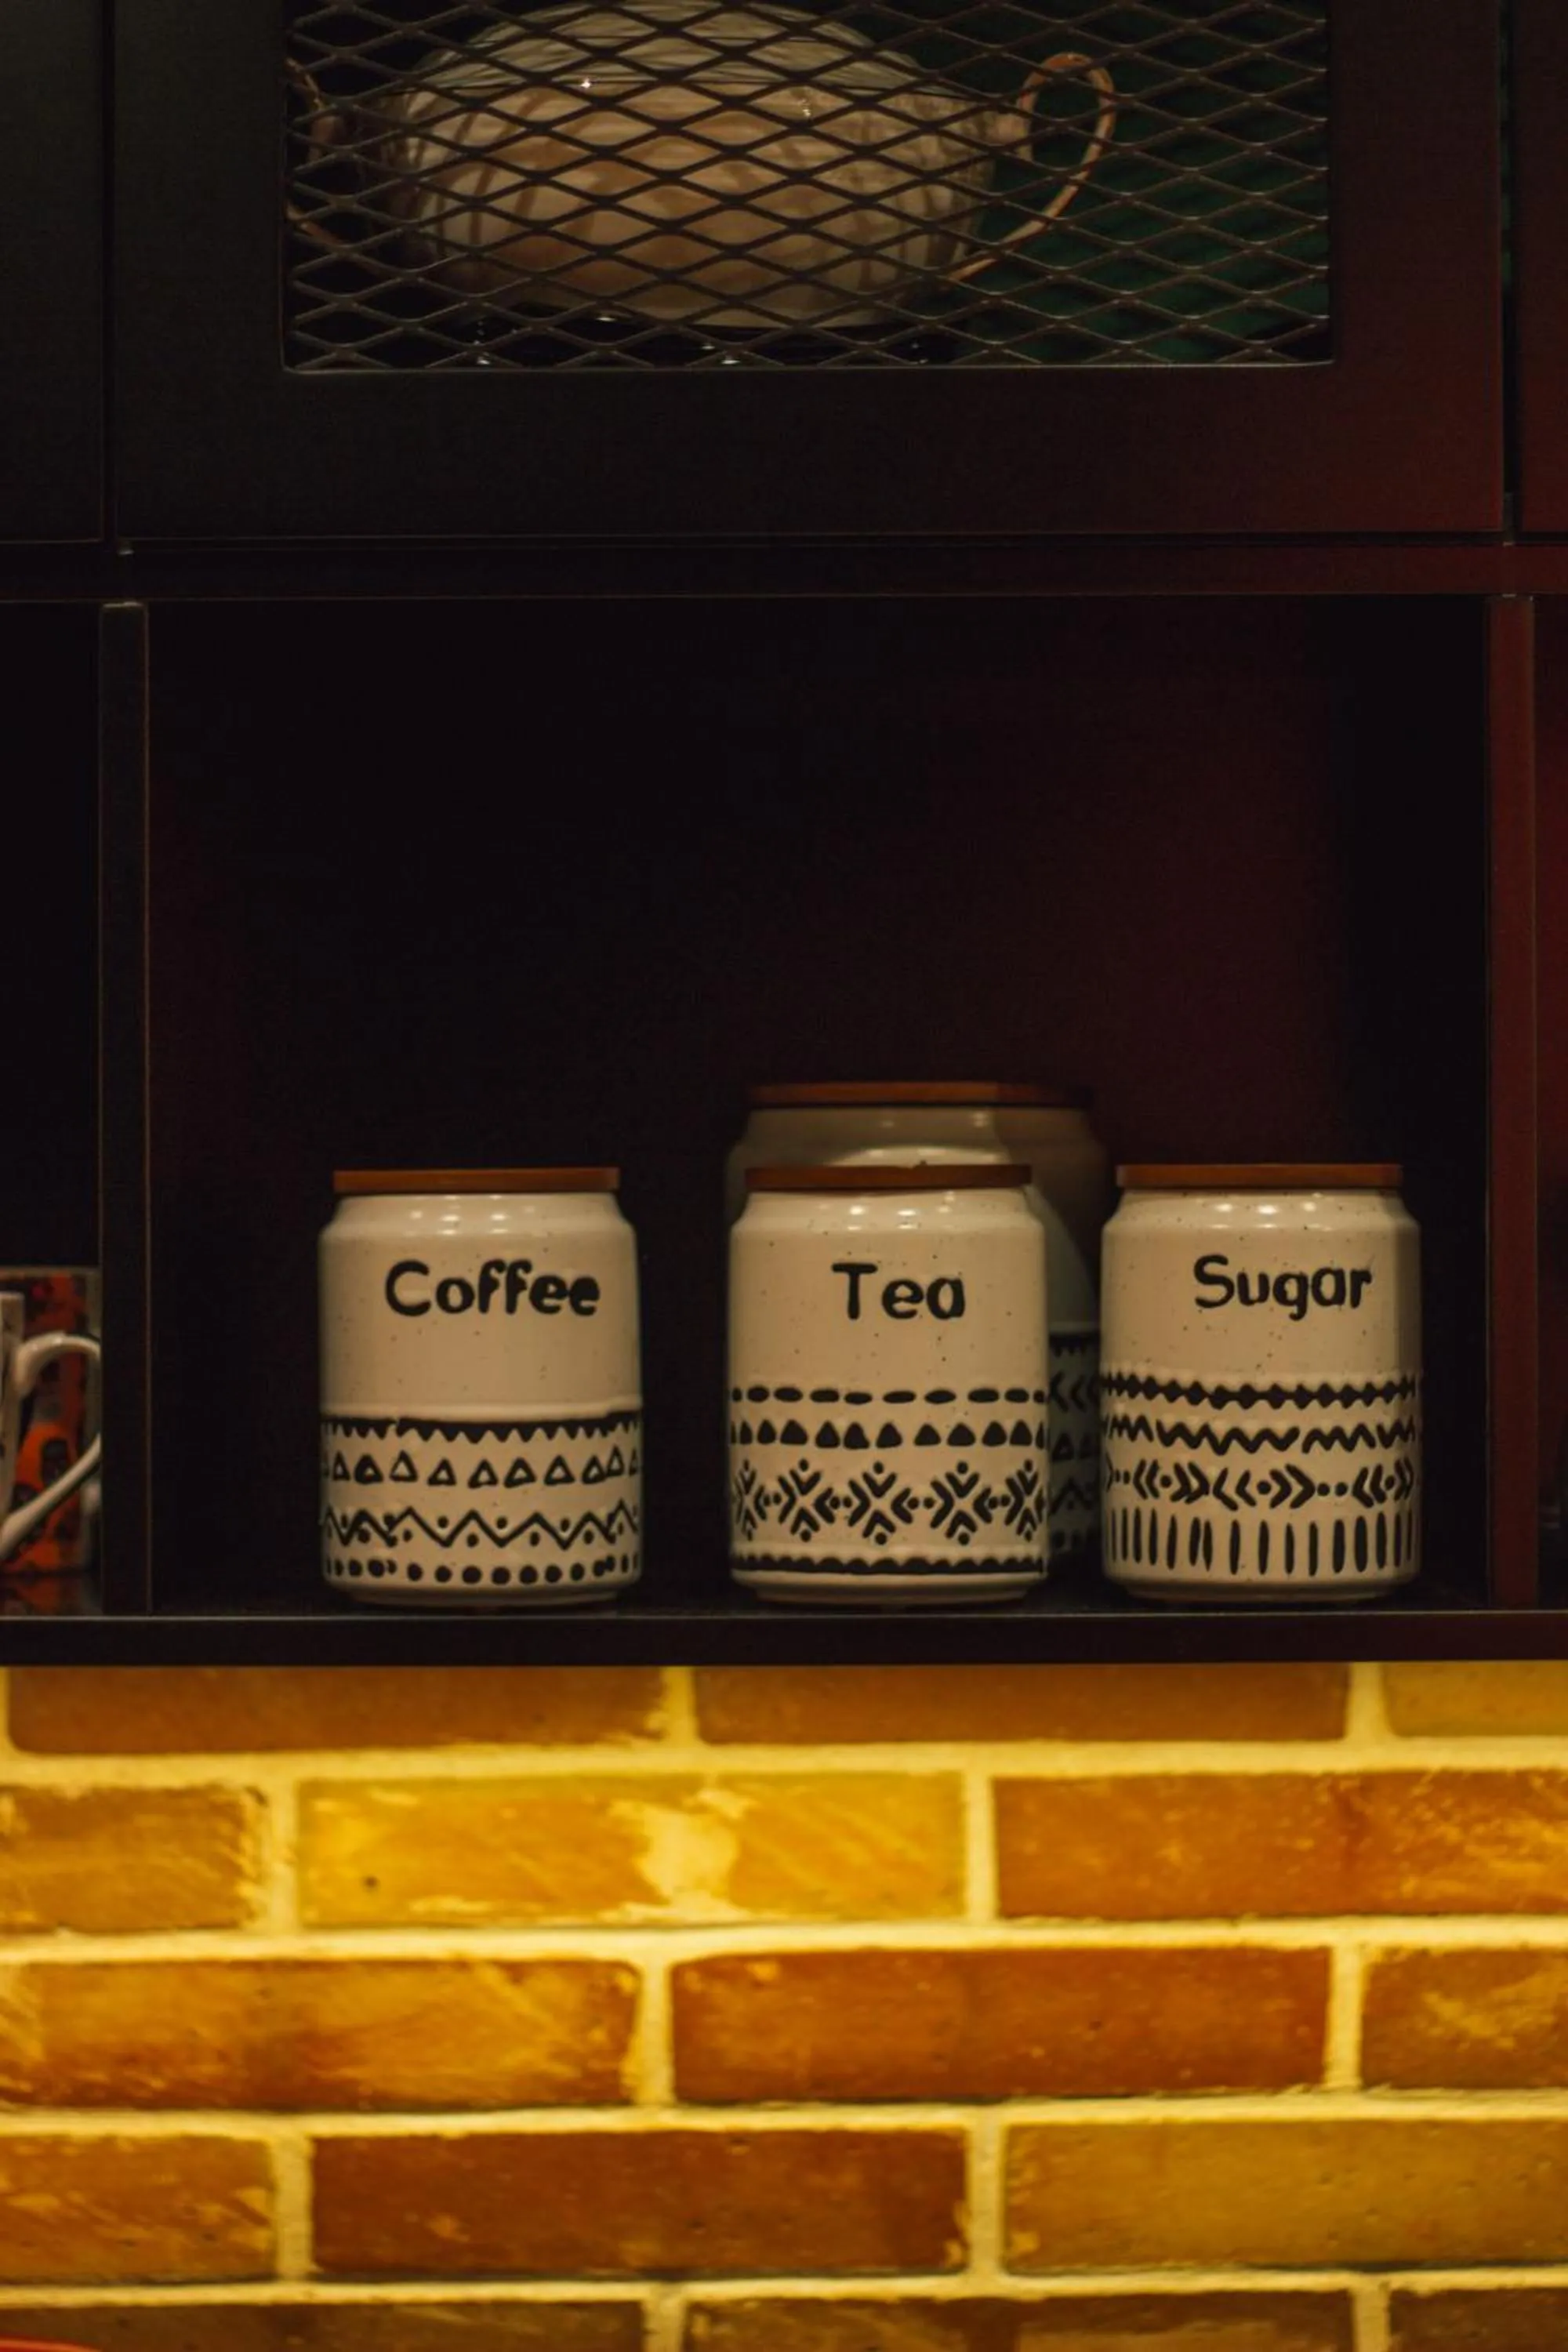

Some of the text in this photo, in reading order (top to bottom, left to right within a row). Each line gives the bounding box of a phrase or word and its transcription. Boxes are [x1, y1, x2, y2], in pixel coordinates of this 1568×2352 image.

[384, 1258, 601, 1318] Coffee
[831, 1262, 967, 1321] Tea
[1192, 1253, 1374, 1322] Sugar
